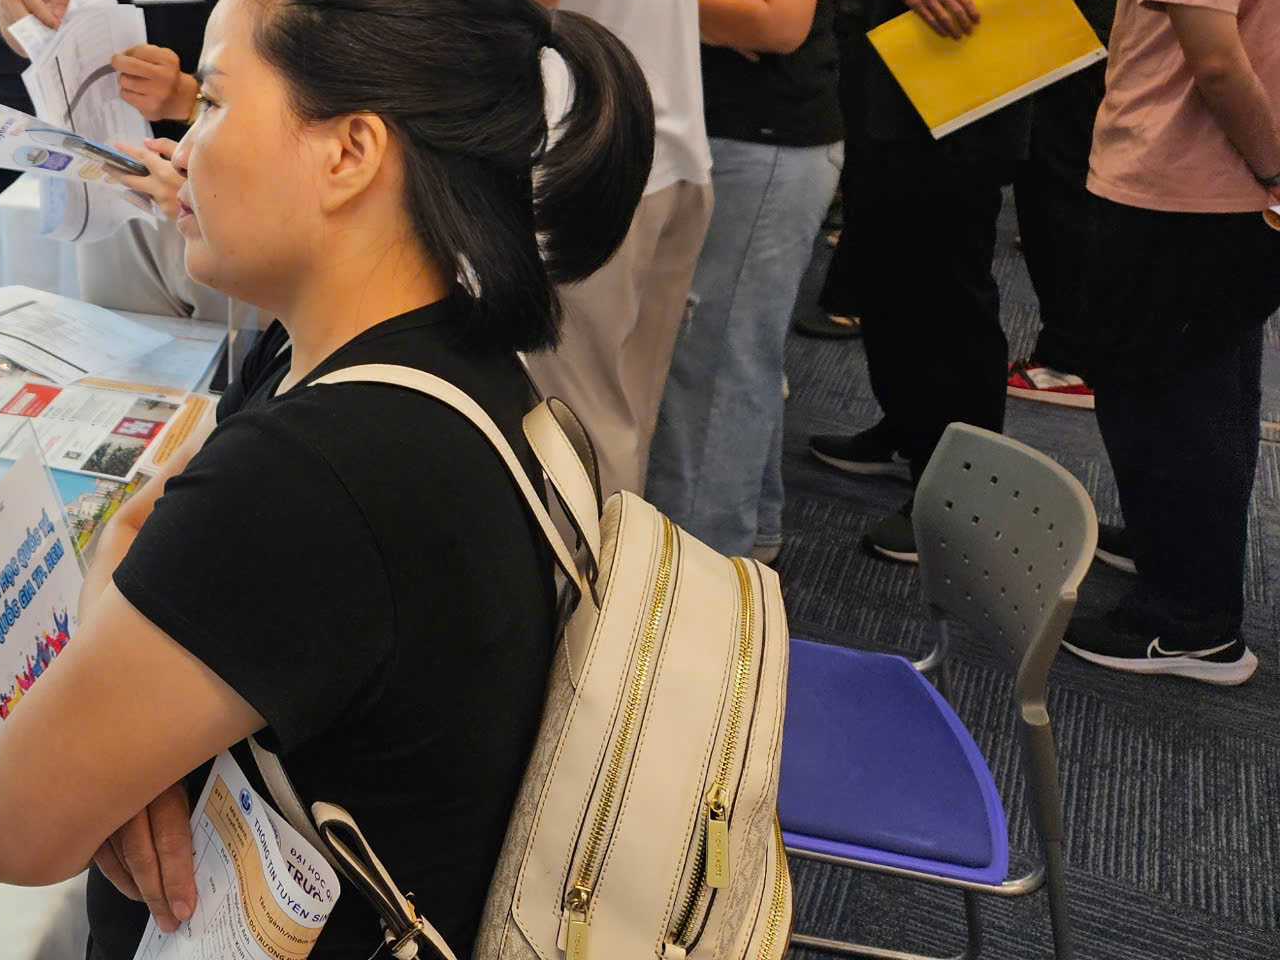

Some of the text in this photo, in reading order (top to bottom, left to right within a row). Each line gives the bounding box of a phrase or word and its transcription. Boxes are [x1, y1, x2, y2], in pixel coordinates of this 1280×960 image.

[17, 527, 42, 568] QUỐC
[18, 579, 37, 609] GIA
[290, 848, 306, 865] ĐẠI
[267, 858, 278, 882] TIN
[248, 919, 257, 933] DO
[241, 928, 250, 945] Anh
